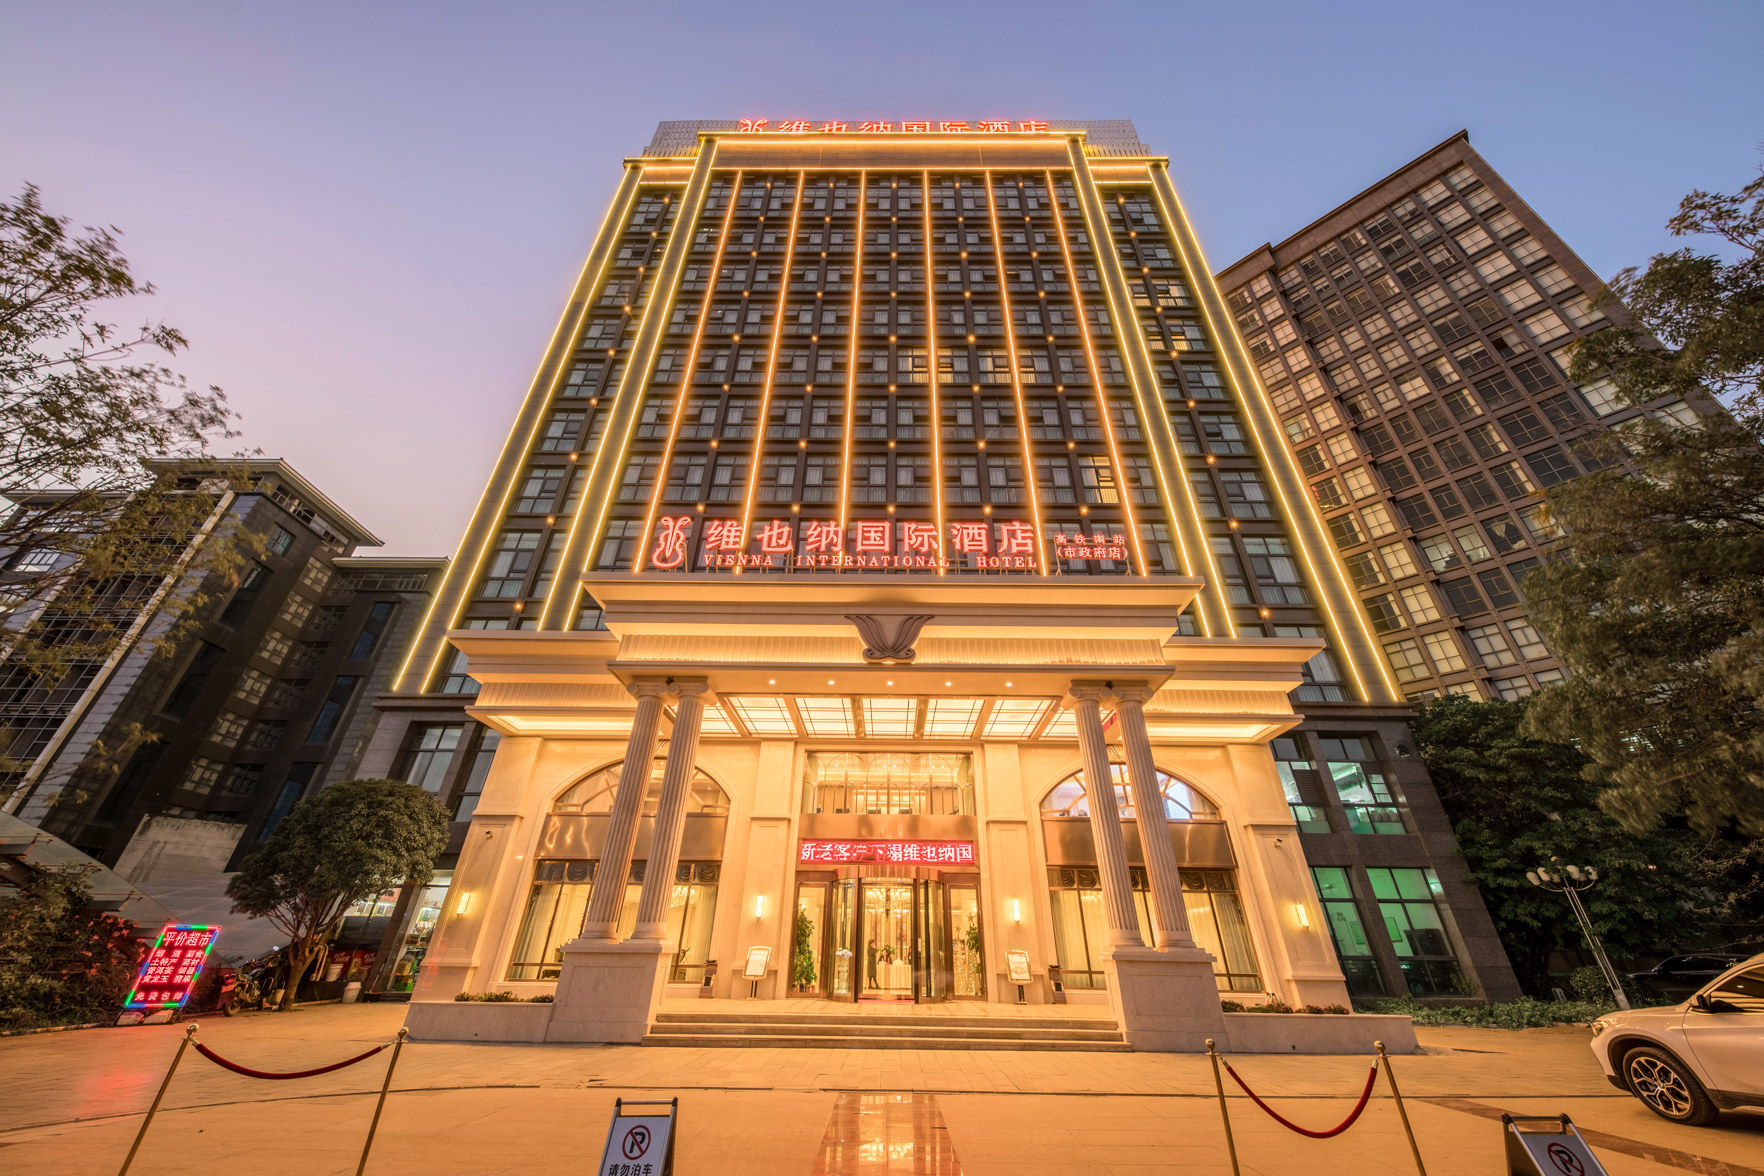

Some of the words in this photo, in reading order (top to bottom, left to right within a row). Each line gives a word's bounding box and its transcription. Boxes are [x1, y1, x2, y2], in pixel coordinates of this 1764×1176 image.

[705, 520, 1034, 554] 维也纳国际酒店
[1055, 533, 1125, 546] 高铁南站
[703, 554, 774, 567] VIENNA
[796, 554, 950, 568] INTERNATIONAL
[976, 556, 1037, 569] HOTEL
[163, 931, 212, 947] 平价超市
[150, 958, 177, 966] 土特产
[146, 966, 173, 975] 普洱茶
[142, 975, 169, 983] 黄龙玉
[134, 991, 184, 1001] 免费包邮
[608, 1163, 653, 1176] 请勿泊车
